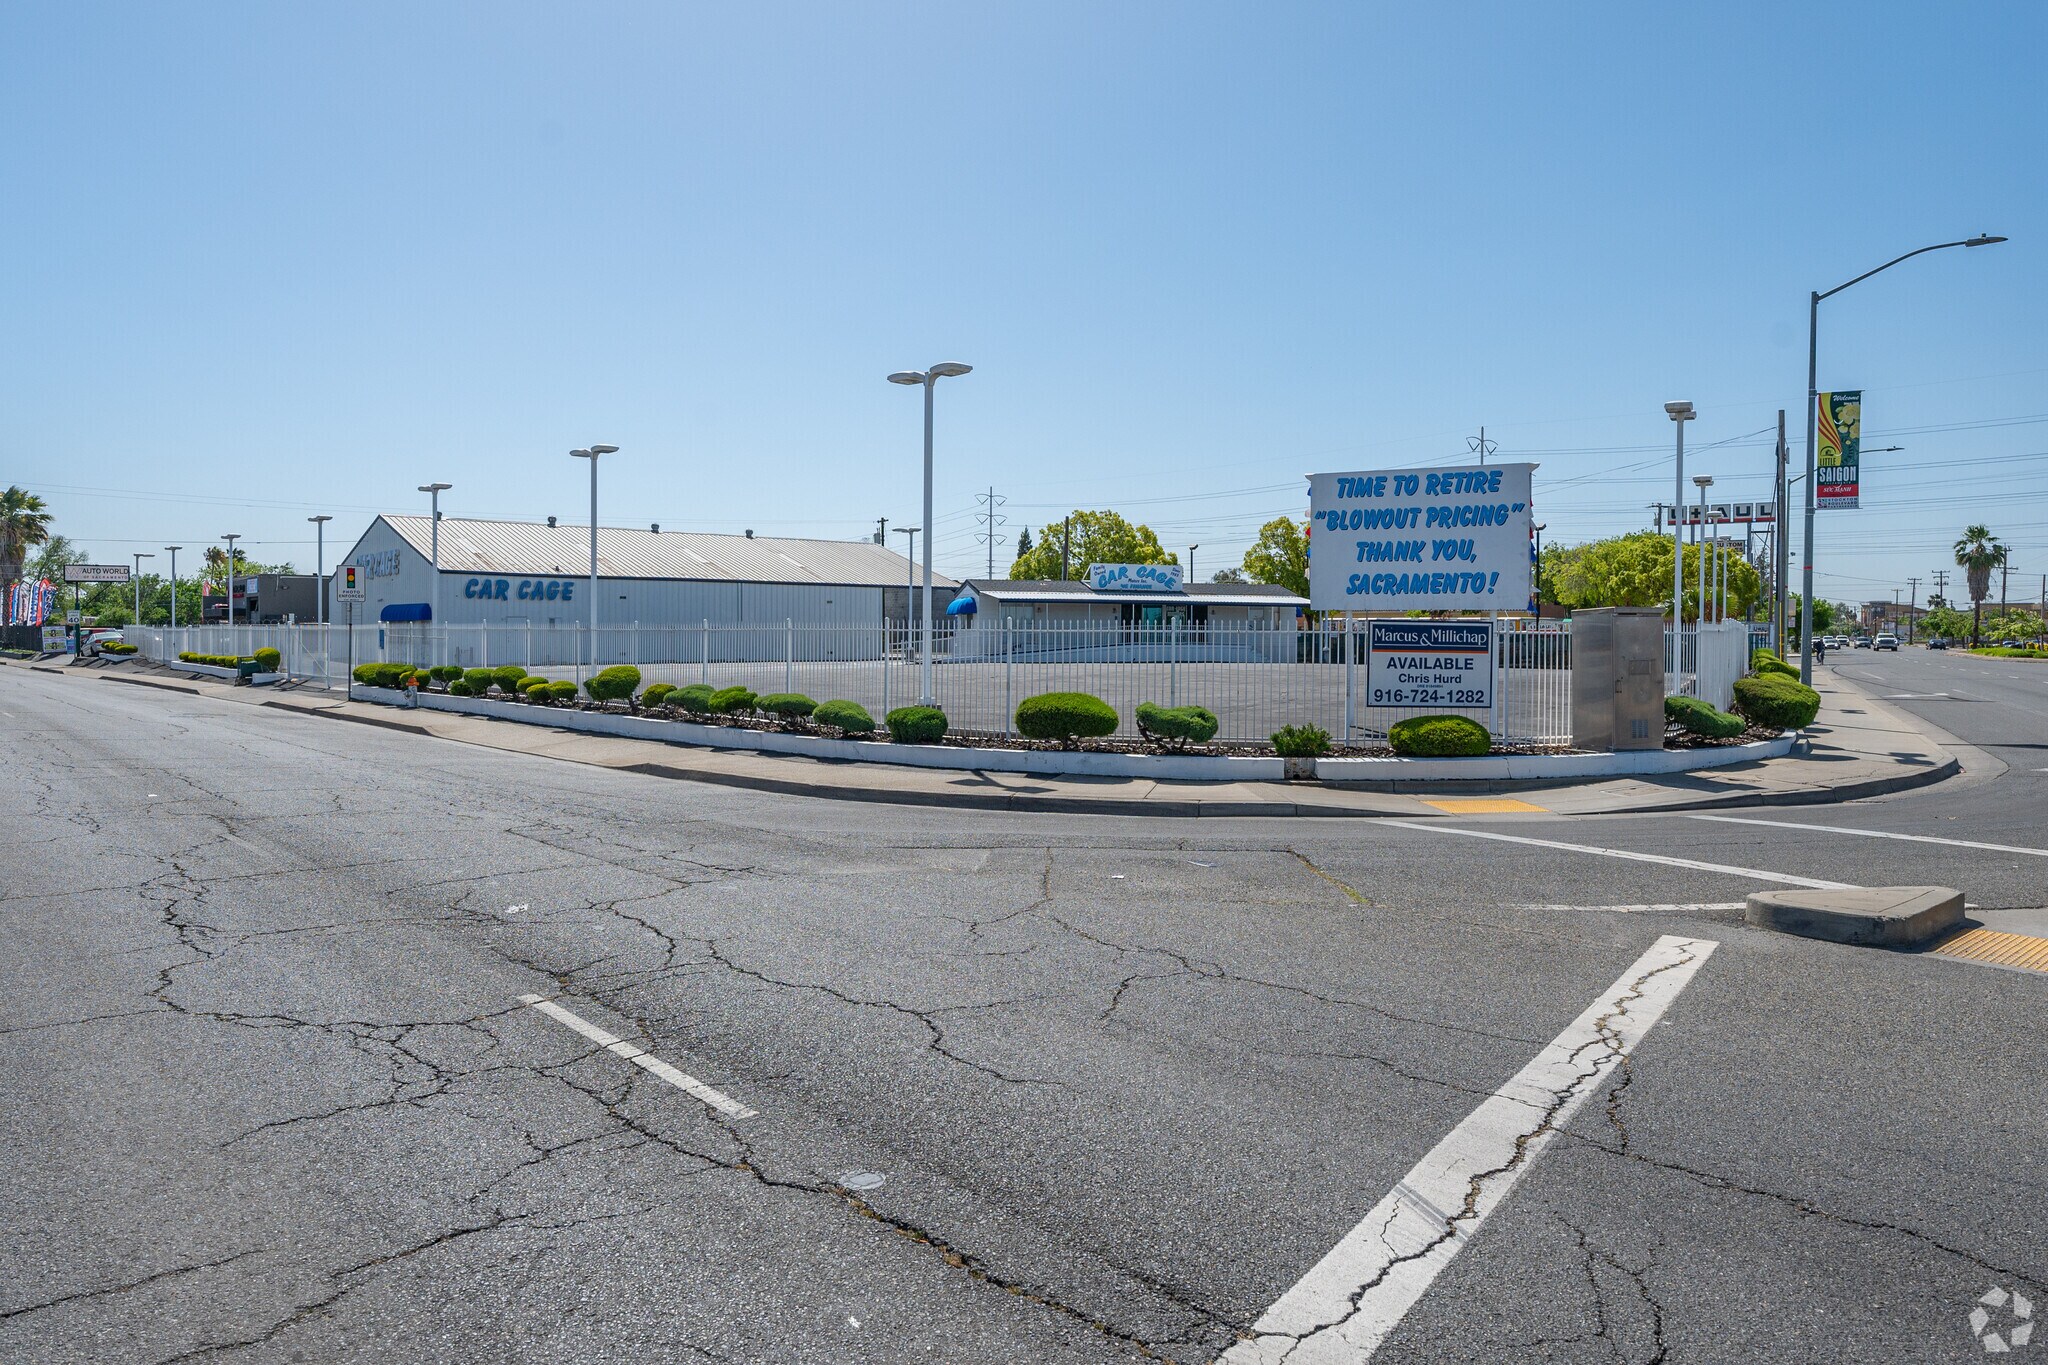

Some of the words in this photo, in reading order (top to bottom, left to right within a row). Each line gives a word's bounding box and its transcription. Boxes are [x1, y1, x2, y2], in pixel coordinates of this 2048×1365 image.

[1820, 458, 1836, 466] LITTLE
[1337, 476, 1387, 498] TIME
[1394, 474, 1419, 496] TO
[1425, 470, 1503, 496] RETIRE
[1820, 466, 1857, 482] SAIGON
[1314, 507, 1422, 531] "BLOWOUT
[1425, 503, 1525, 529] PRICING"
[1356, 540, 1426, 563] THANK
[1431, 539, 1477, 563] YOU,
[1098, 566, 1128, 588] CAR
[1136, 566, 1176, 590] CAGE
[1346, 572, 1499, 597] SACRAMENTO!
[465, 578, 510, 601] CAR
[517, 580, 575, 601] CAGE
[1374, 628, 1419, 642] Marcus
[1420, 633, 1432, 646] &
[1431, 629, 1487, 645] Millichap
[1386, 657, 1474, 670] AVAILABLE
[1398, 673, 1430, 683] Chris
[1433, 674, 1462, 684] Hurd
[1374, 689, 1484, 703] 916-724-1282
